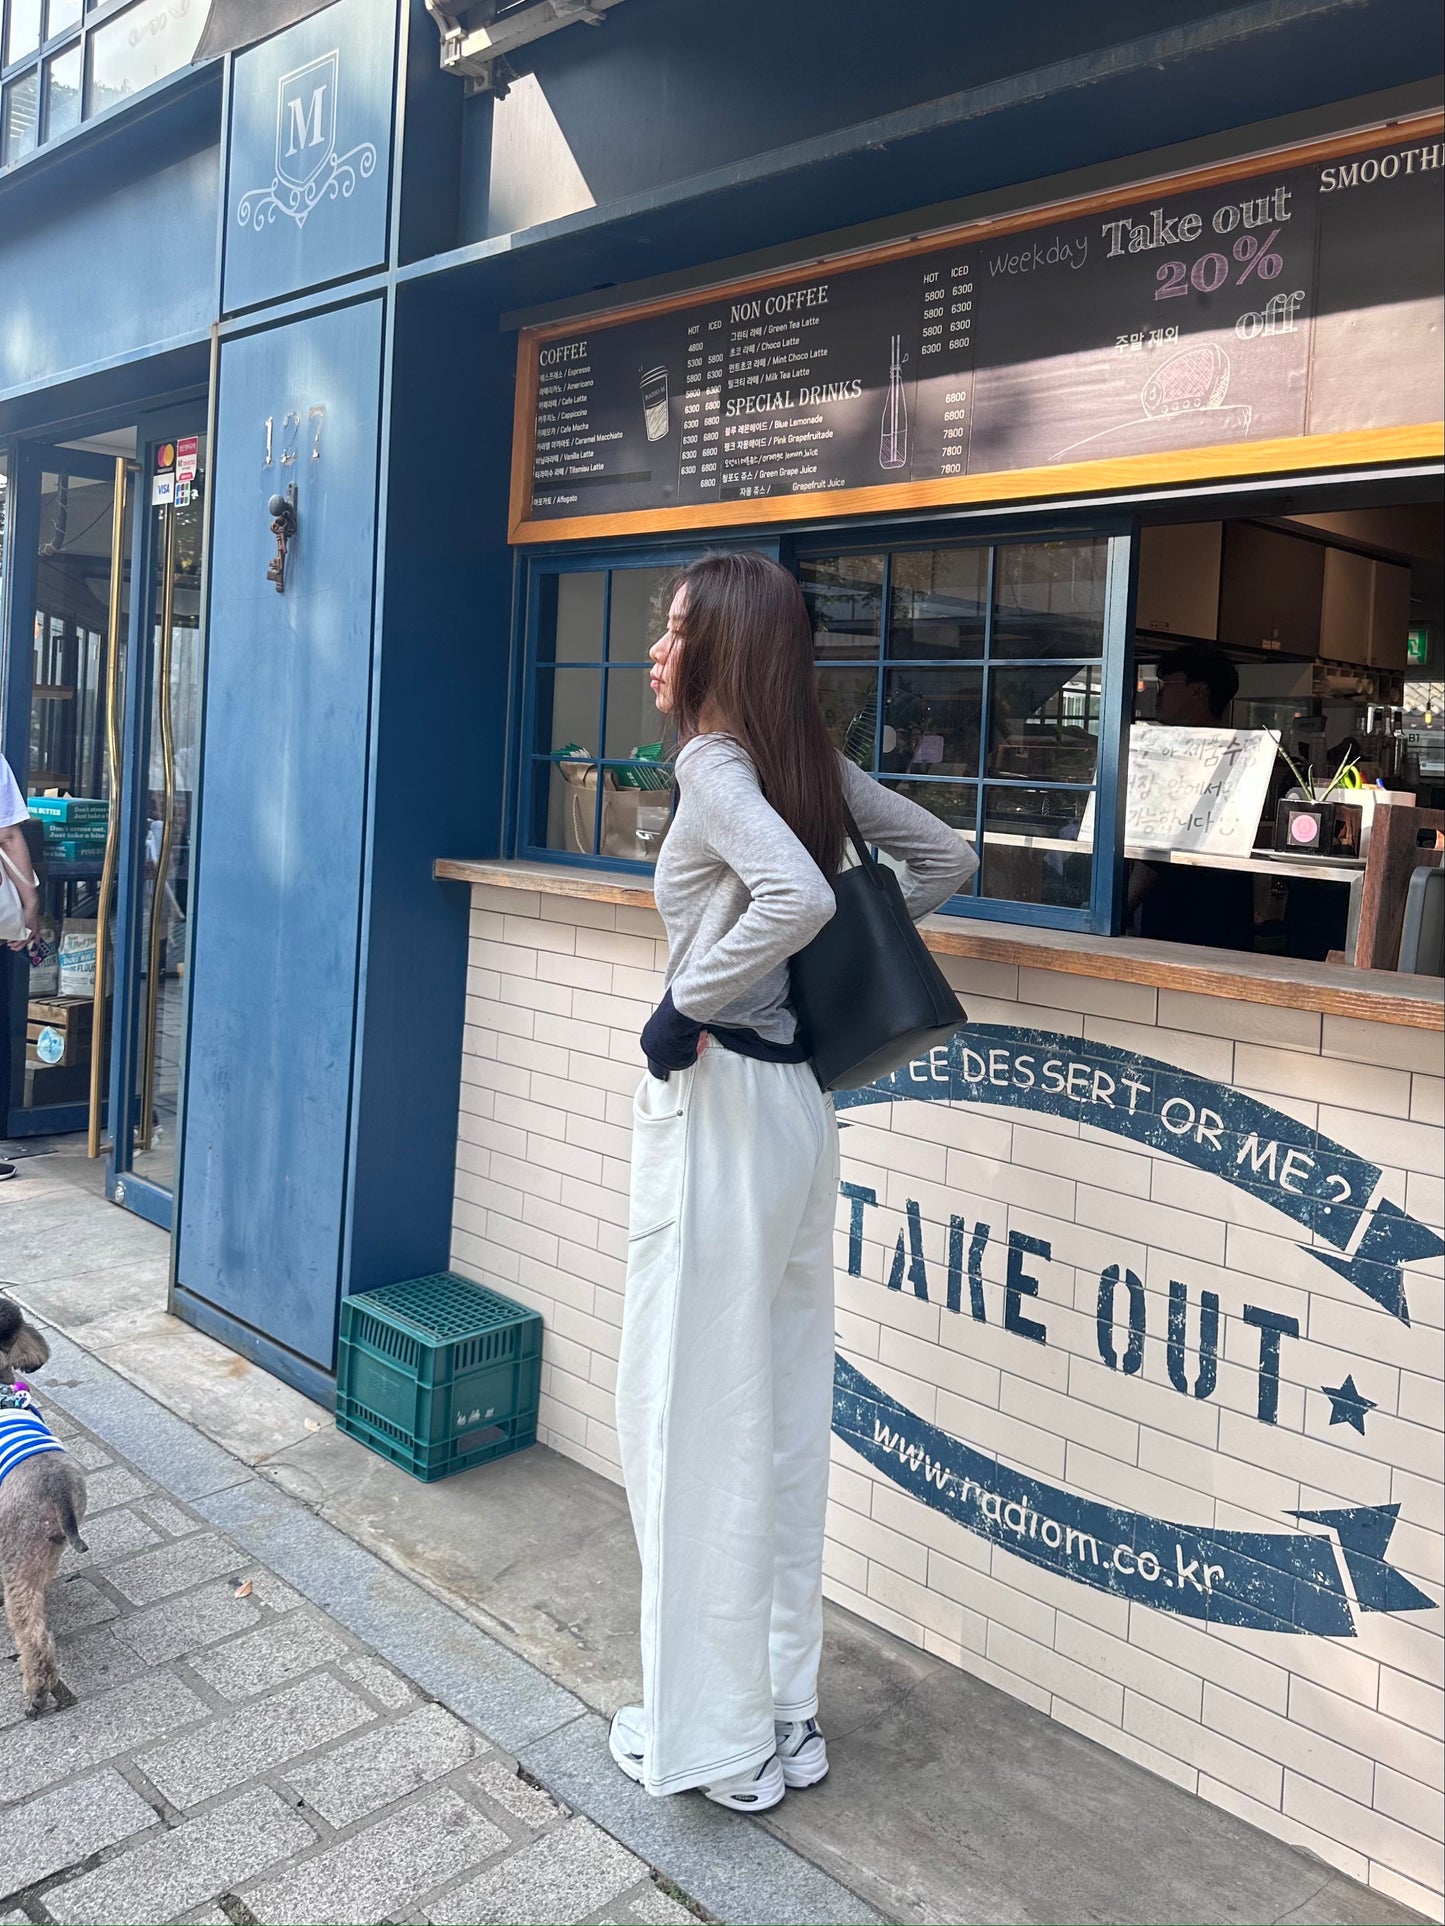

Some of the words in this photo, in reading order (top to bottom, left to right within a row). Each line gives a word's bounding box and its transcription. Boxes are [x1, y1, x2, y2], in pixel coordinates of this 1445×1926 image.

[285, 84, 327, 157] M
[1102, 207, 1202, 258] Take
[1212, 186, 1292, 234] out
[1154, 229, 1284, 301] 20%
[924, 272, 939, 284] HOT
[951, 266, 969, 278] ICED
[925, 289, 945, 302] 5800
[952, 283, 973, 296] 6300
[730, 300, 761, 323] NON
[765, 285, 828, 315] COFFEE
[924, 307, 944, 320] 5800
[951, 301, 972, 314] 6300
[1235, 290, 1306, 340] off
[688, 325, 700, 335] HOT
[708, 320, 722, 331] ICED
[768, 324, 787, 333] Green
[789, 321, 800, 329] Tea
[802, 317, 819, 327] Latte
[922, 325, 942, 337] 5800
[950, 319, 970, 332] 6300
[761, 341, 780, 351] Choco
[782, 337, 800, 346] Latte
[921, 343, 941, 355] 6300
[949, 337, 969, 350] 6800
[1114, 331, 1145, 353] 주말
[1148, 326, 1180, 348] 제외
[539, 341, 588, 366] COFFEE
[708, 354, 724, 364] 5800
[772, 355, 787, 365] Mint
[788, 352, 808, 362] Choco
[810, 348, 828, 358] Latte
[568, 366, 591, 377] Espresso
[686, 373, 702, 383] 5800
[707, 369, 723, 380] 6300
[765, 372, 778, 381] Milk
[780, 370, 791, 379] Tea
[792, 368, 810, 377] Latte
[726, 390, 795, 417] SPECIAL
[799, 379, 862, 406] DRINKS
[945, 391, 966, 404] 6800
[684, 404, 700, 414] 6300
[944, 409, 965, 422] 6800
[684, 419, 699, 430] 6300
[704, 416, 720, 427] 6800
[774, 419, 789, 429] Blue
[790, 414, 824, 427] Lemonade
[683, 434, 698, 445] 6300
[703, 432, 719, 442] 6800
[774, 436, 787, 445] Pink
[943, 428, 964, 440] 7800
[682, 450, 697, 460] 6300
[702, 447, 718, 457] 6800
[942, 445, 962, 457] 7800
[681, 464, 696, 475] 6300
[701, 463, 717, 473] 6800
[760, 469, 778, 479] Green
[780, 466, 799, 478] Grape
[800, 464, 817, 475] Juice
[940, 463, 961, 475] 7800
[700, 478, 716, 488] 6800
[792, 479, 826, 491] Grapefruit
[827, 478, 846, 488] Juice
[962, 1047, 1153, 1117] DESSERT
[1160, 1098, 1224, 1152] OR
[839, 1180, 1051, 1345] TAKE
[1097, 1263, 1300, 1427] OUT
[873, 1417, 1224, 1595] www.radiom.co.kr
